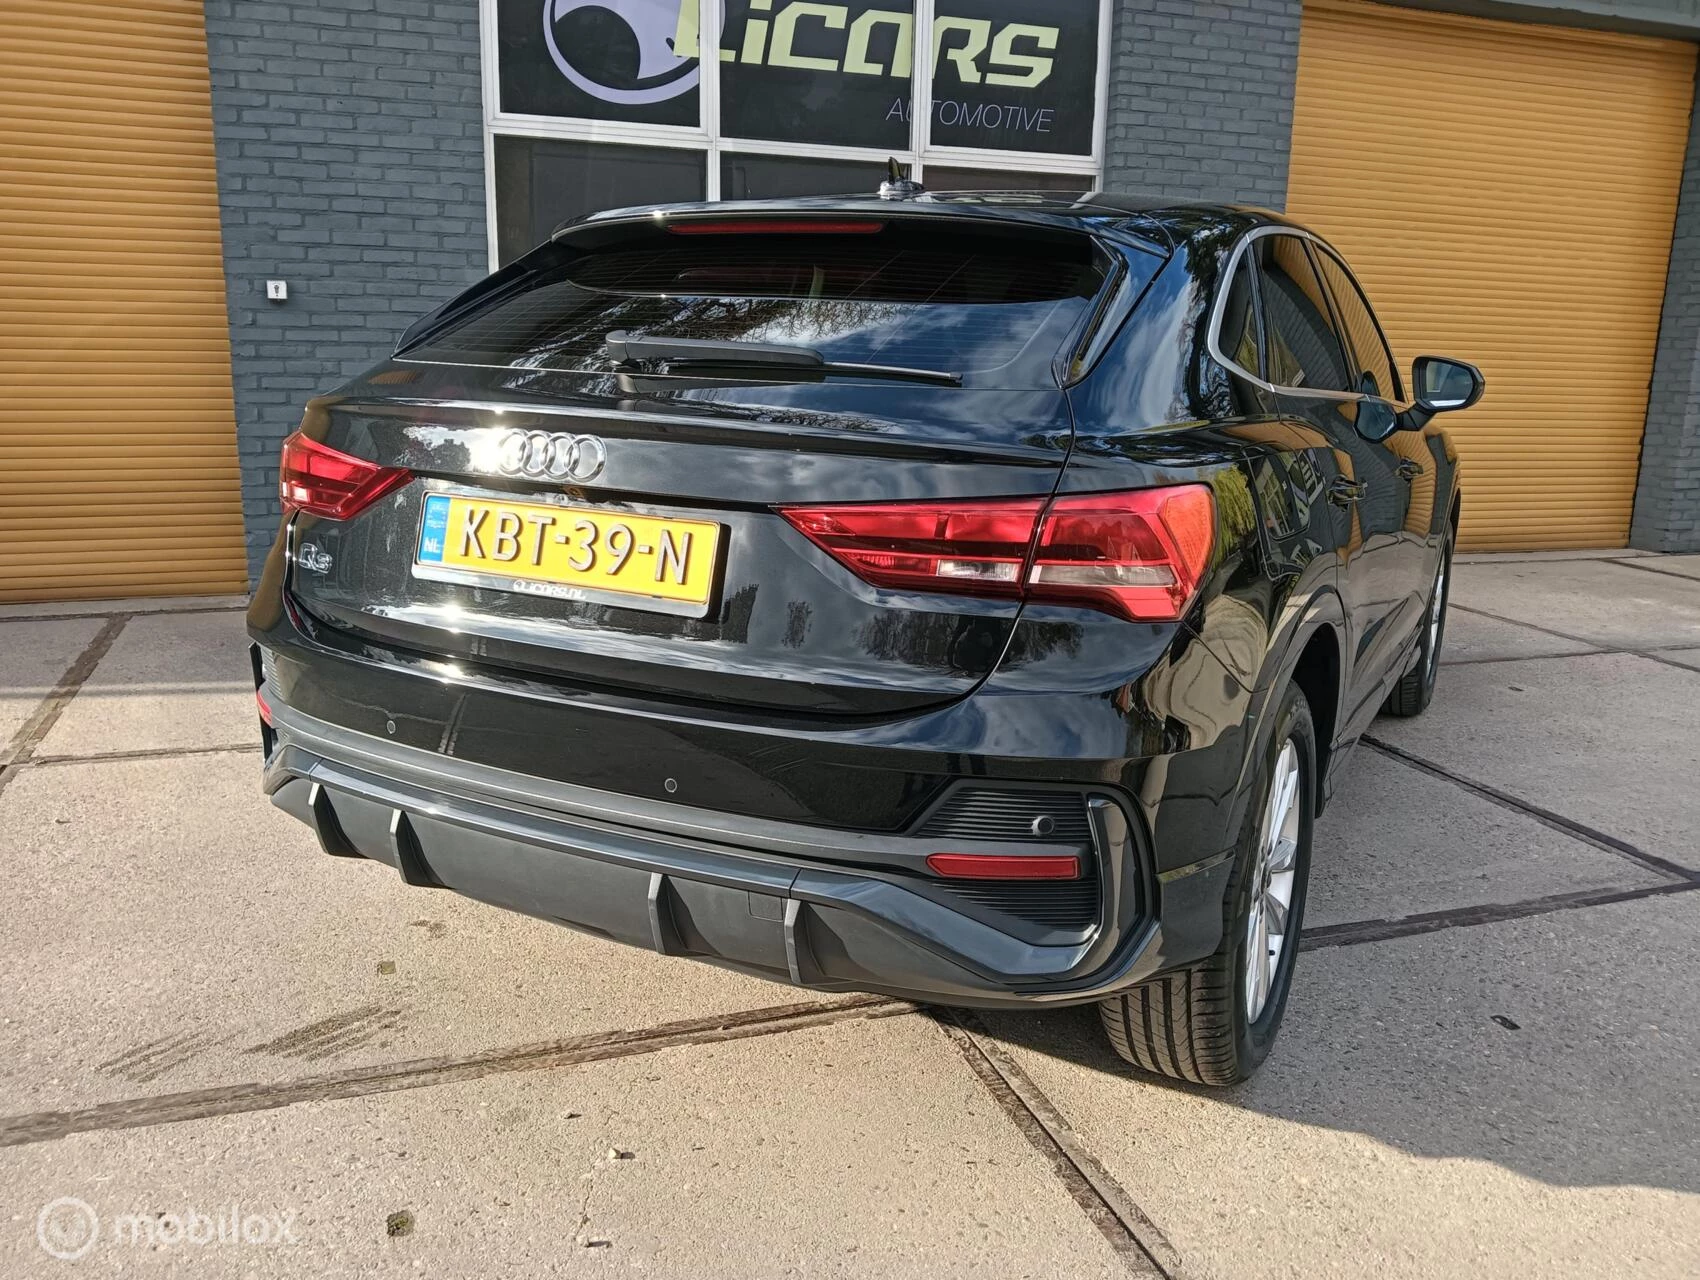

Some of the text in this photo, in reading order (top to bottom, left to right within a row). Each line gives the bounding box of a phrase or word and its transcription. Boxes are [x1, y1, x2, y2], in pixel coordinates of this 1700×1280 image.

[299, 542, 333, 574] Q3
[423, 536, 441, 553] NL
[459, 508, 693, 585] KBT-39-N
